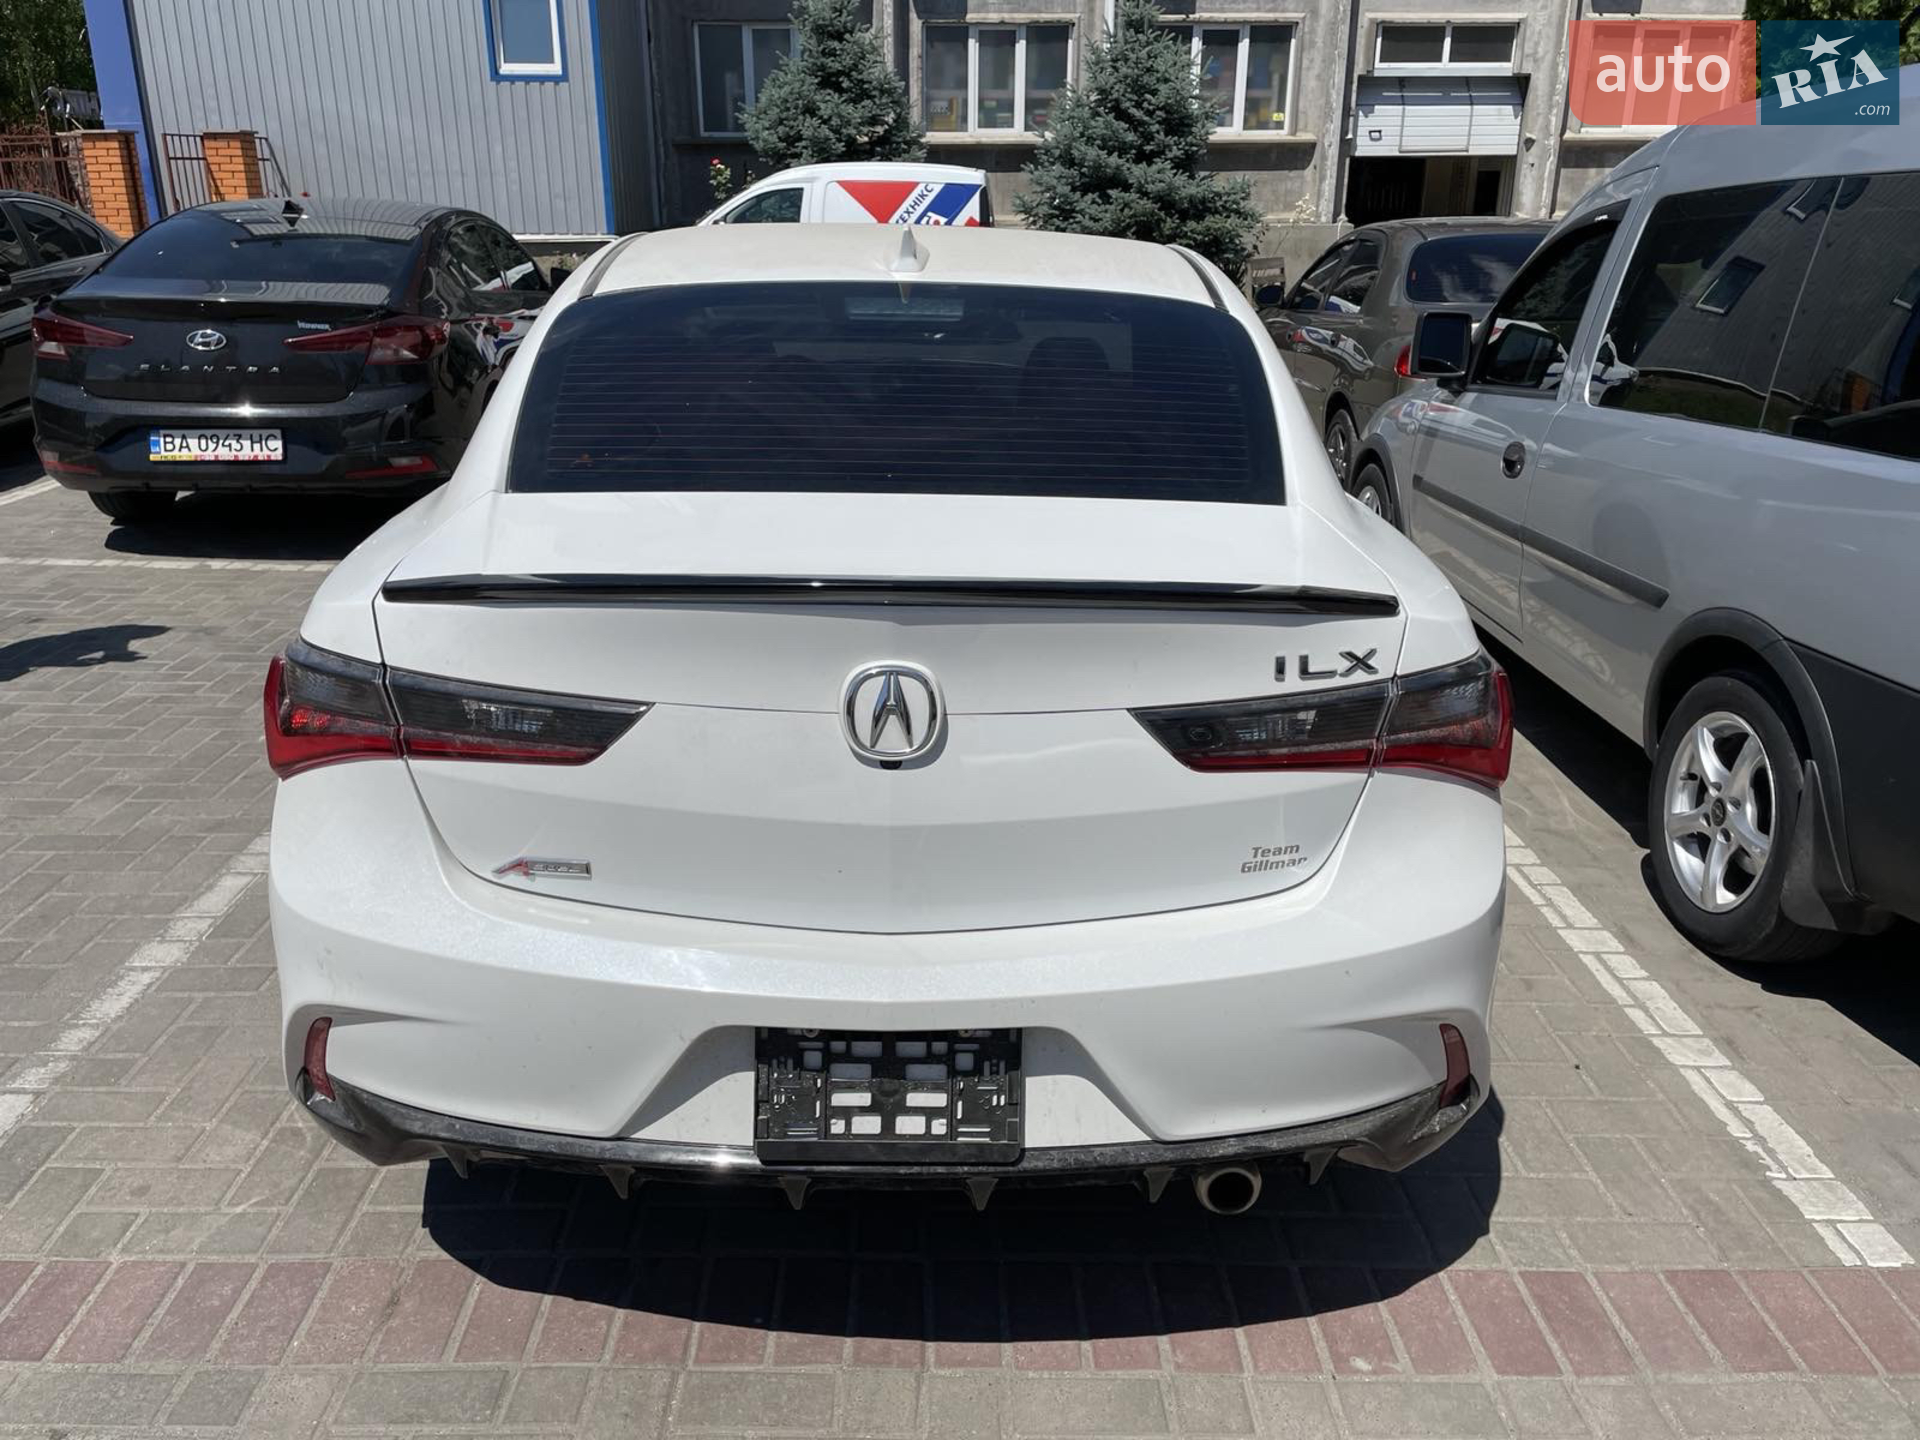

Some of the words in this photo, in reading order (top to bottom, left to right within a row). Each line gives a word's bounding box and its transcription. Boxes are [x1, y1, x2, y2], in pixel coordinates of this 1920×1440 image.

[139, 364, 281, 373] ELANTRA
[162, 434, 191, 453] BA
[197, 434, 244, 453] 0943
[249, 434, 279, 453] HC
[1274, 647, 1379, 682] ILX
[1252, 845, 1300, 859] Team
